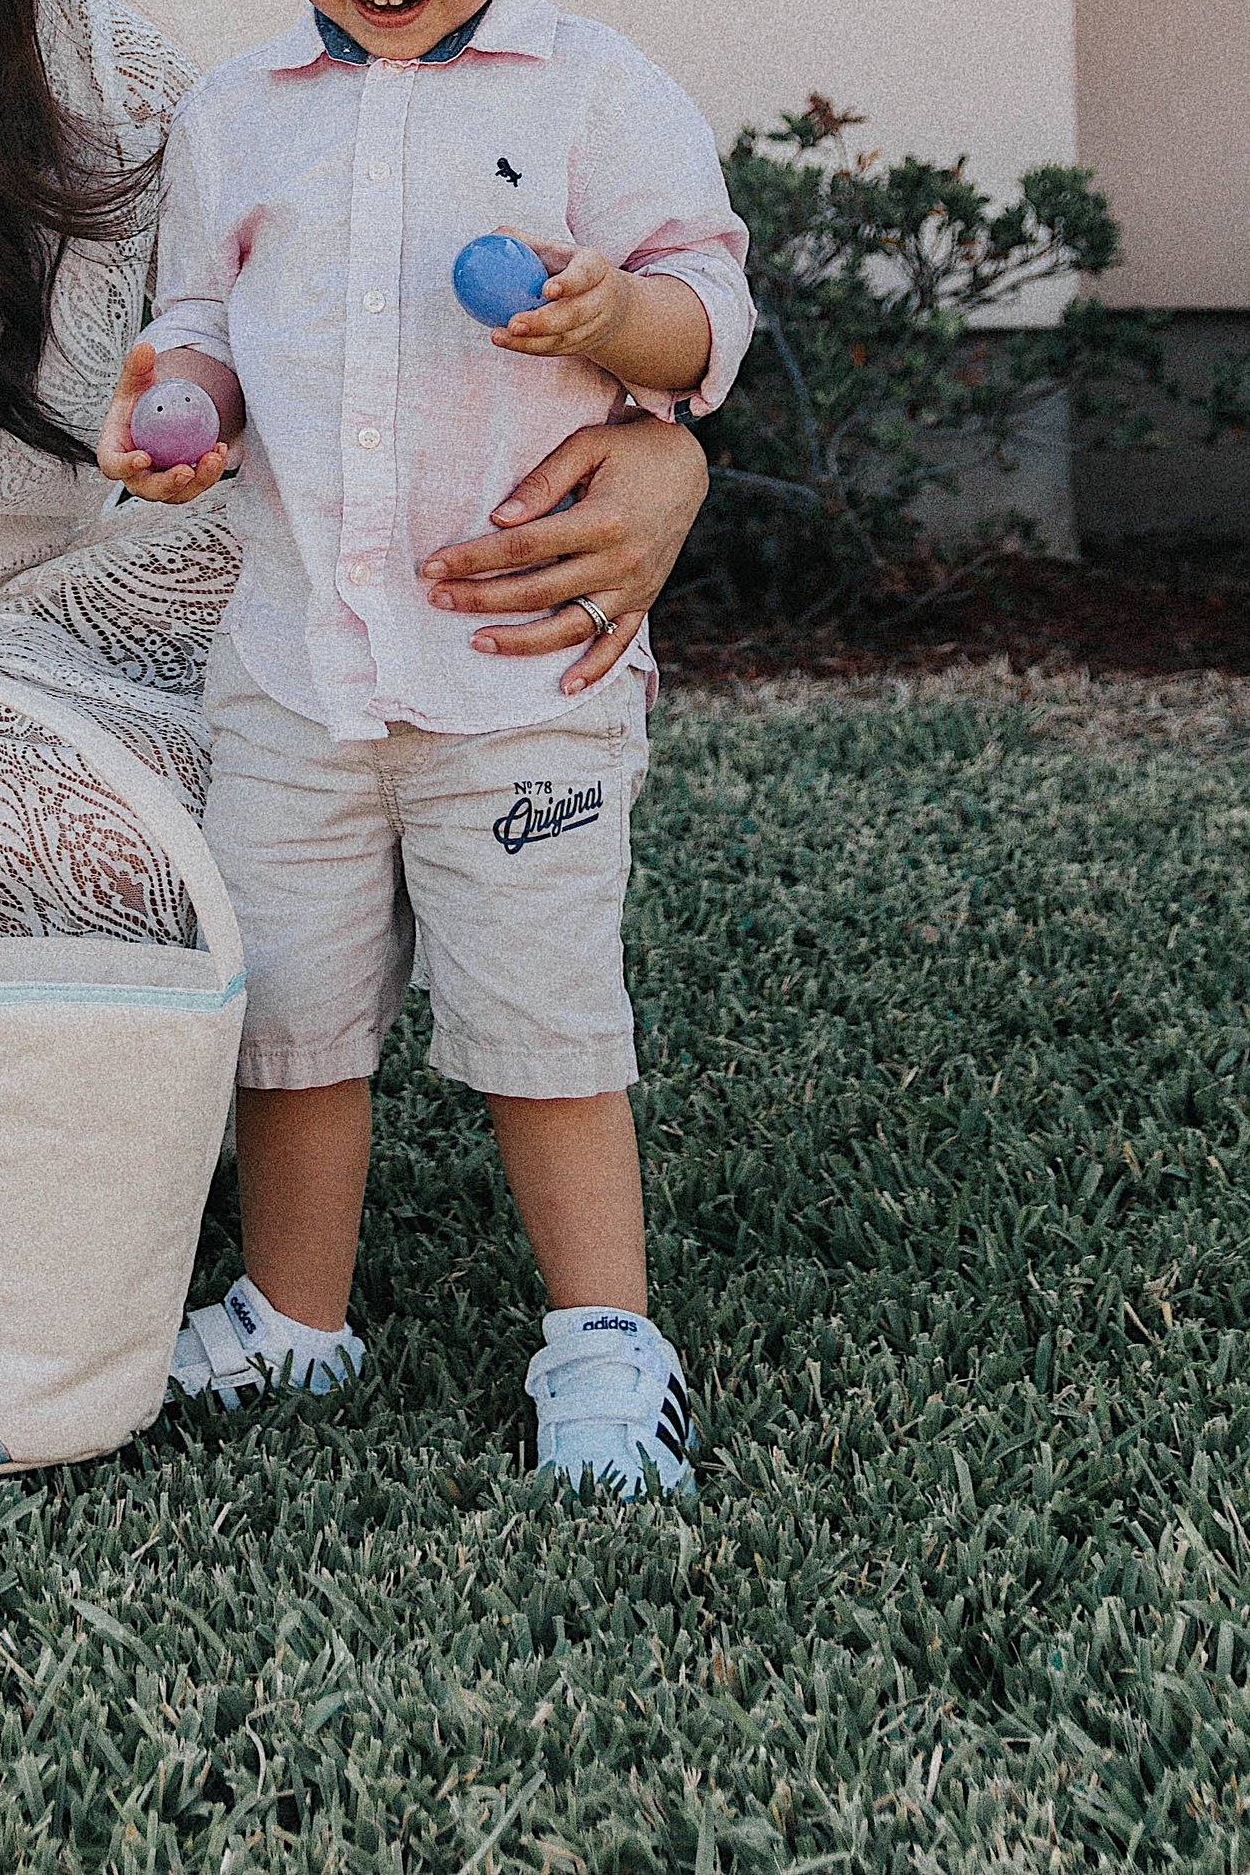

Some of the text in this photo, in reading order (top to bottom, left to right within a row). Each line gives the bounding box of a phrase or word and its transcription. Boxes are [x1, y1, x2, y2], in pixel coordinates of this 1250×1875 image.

[536, 781, 553, 795] 78
[493, 780, 603, 854] Original
[230, 1296, 257, 1335] adidas
[582, 1315, 638, 1332] adidas
